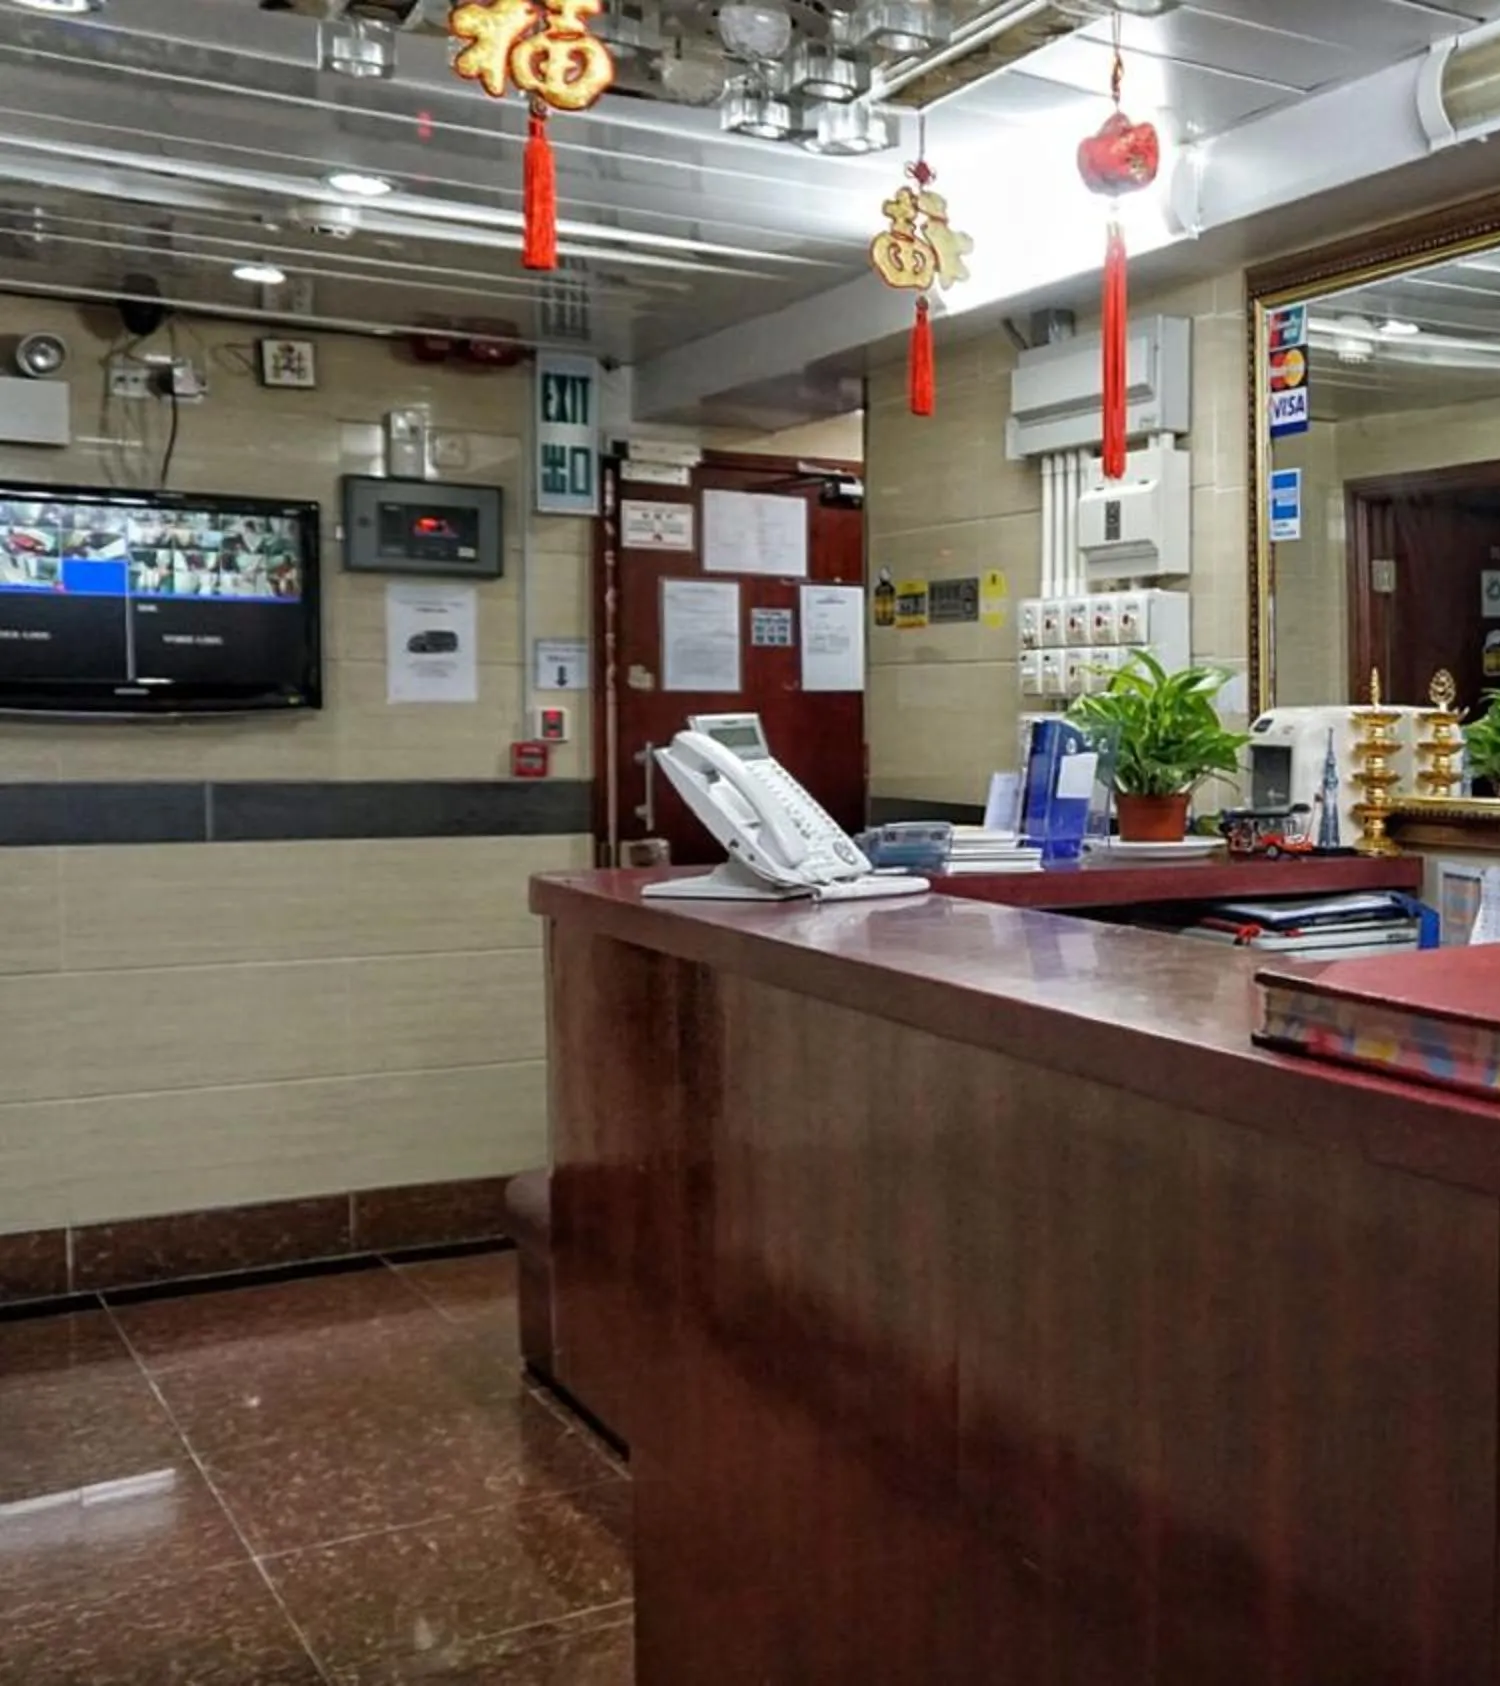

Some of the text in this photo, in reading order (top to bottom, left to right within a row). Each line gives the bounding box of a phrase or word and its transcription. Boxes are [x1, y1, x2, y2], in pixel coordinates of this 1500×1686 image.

[541, 372, 591, 426] EXIT
[1273, 394, 1305, 420] VISA
[541, 443, 592, 496] 出口
